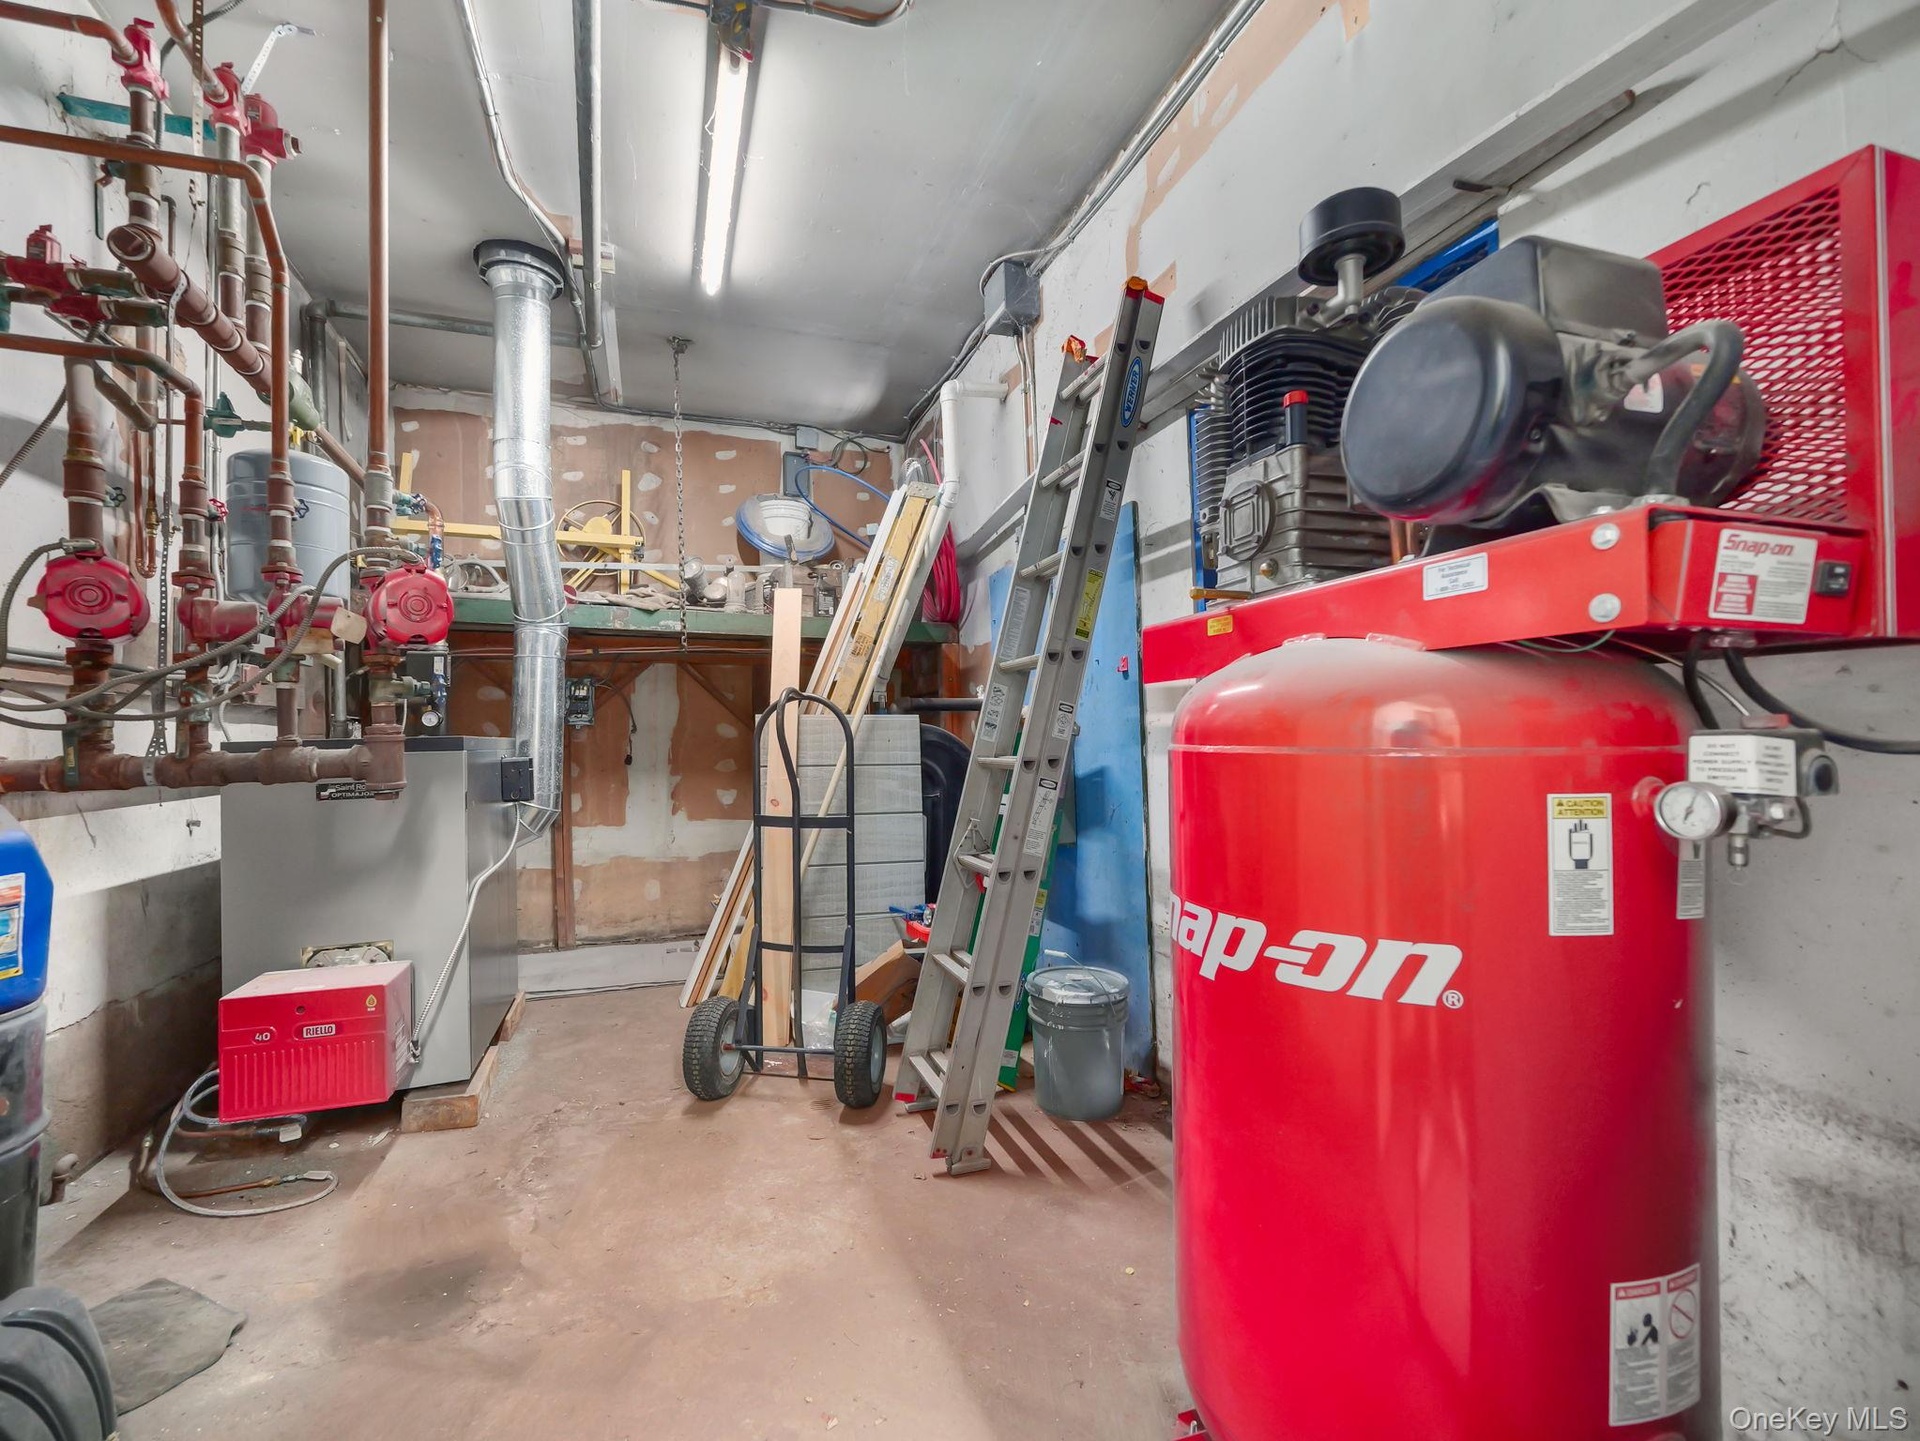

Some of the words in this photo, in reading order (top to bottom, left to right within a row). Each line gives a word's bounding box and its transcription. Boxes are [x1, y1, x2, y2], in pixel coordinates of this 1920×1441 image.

[1125, 370, 1139, 412] WERNER
[1723, 533, 1794, 557] Snap-on
[335, 783, 355, 791] Saint
[1566, 799, 1605, 807] CAUTION
[1557, 808, 1605, 816] ATTENTION
[1171, 890, 1463, 1007] nap-on
[254, 1031, 271, 1042] 40
[305, 1025, 334, 1037] RIELLO
